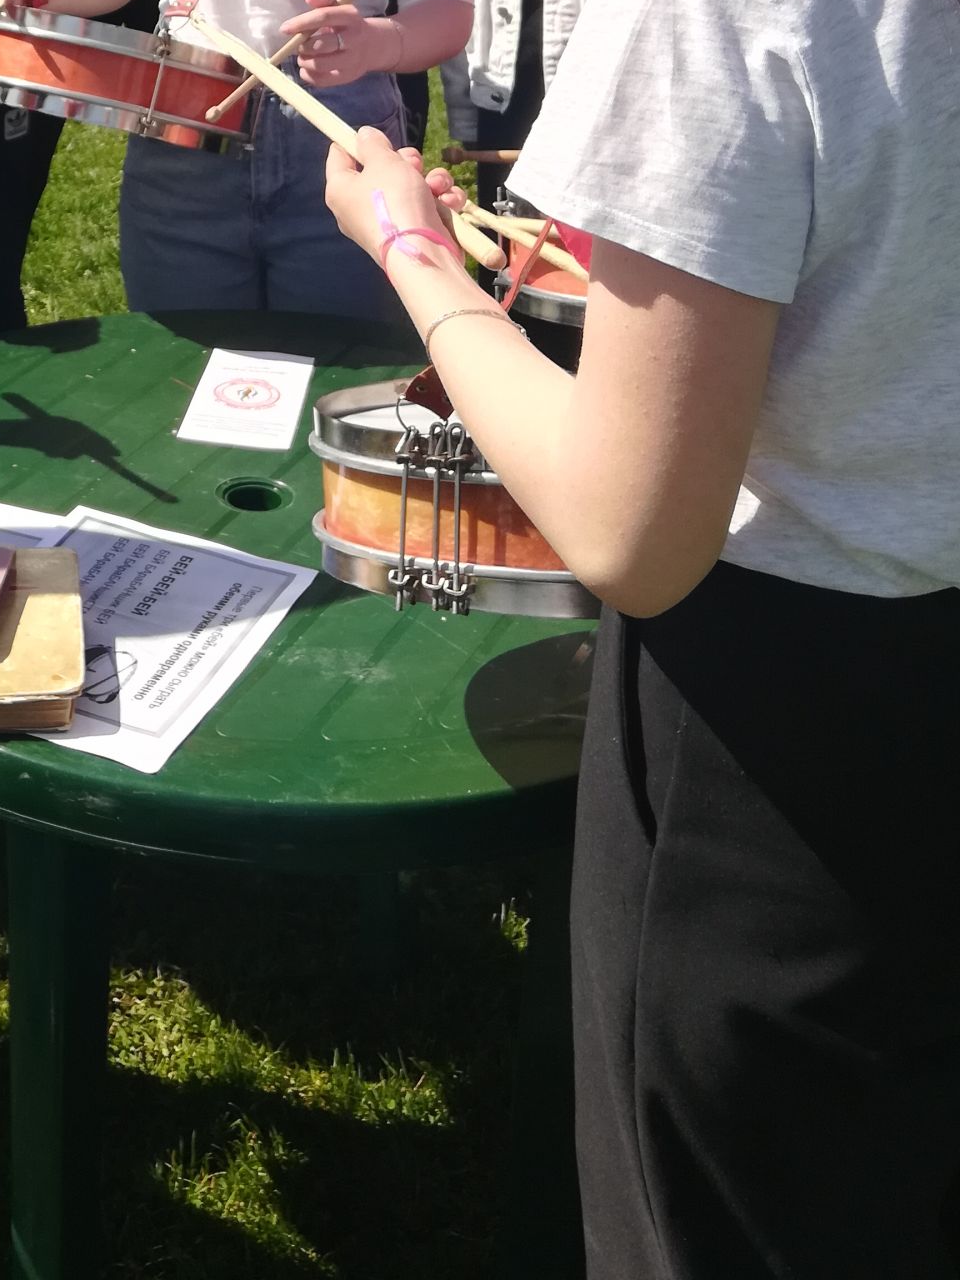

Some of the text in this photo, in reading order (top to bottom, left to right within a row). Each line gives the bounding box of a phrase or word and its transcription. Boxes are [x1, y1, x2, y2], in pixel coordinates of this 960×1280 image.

[130, 554, 195, 617] БЕЙ-БЕЙ-БЕЙ
[213, 582, 243, 611] обеими
[188, 610, 218, 640] руками
[178, 650, 206, 678] можно
[147, 677, 182, 710] сыграть
